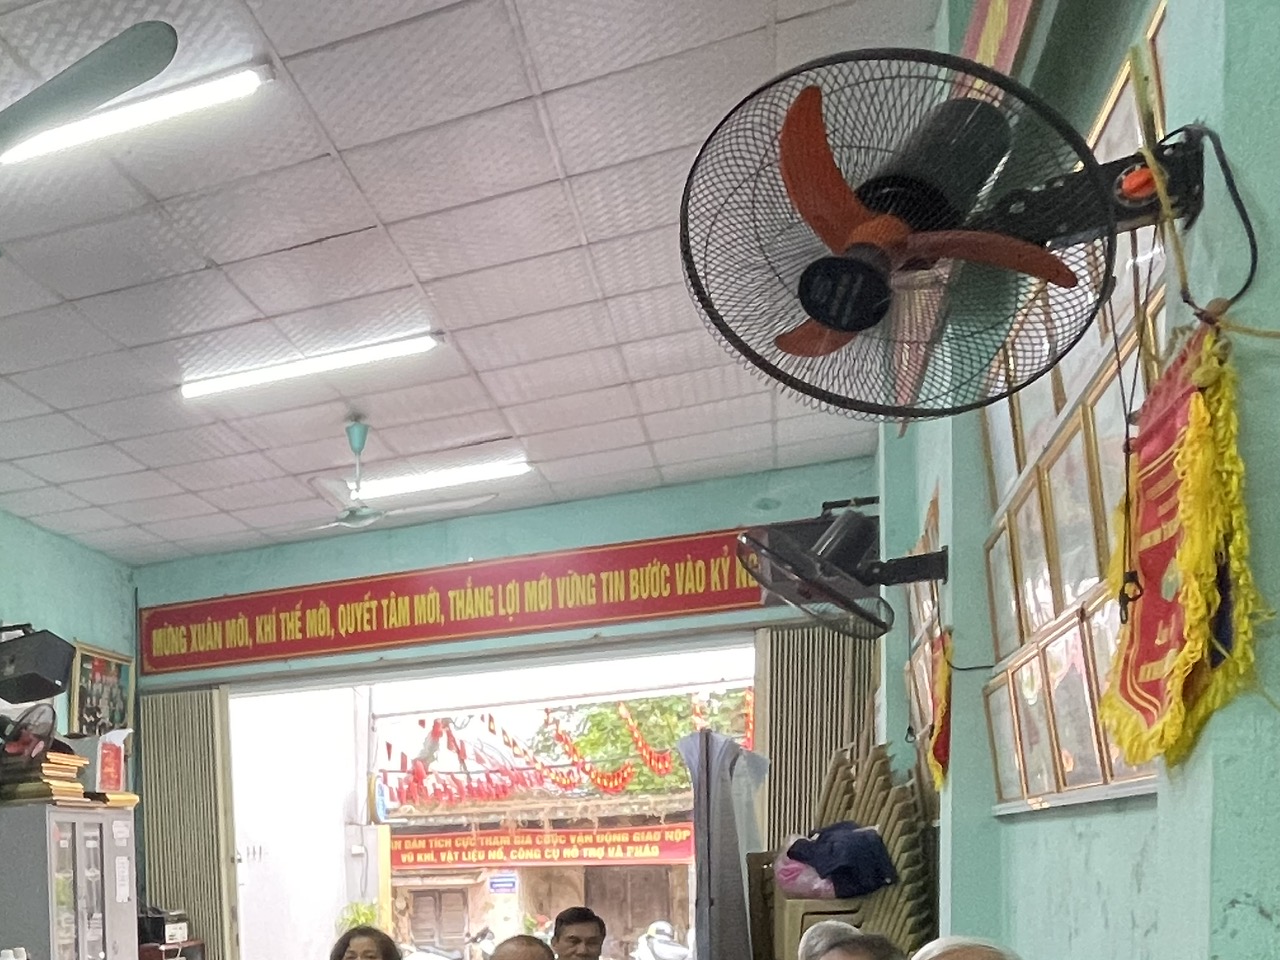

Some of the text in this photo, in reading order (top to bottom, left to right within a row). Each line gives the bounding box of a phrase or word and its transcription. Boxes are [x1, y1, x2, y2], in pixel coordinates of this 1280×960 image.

[152, 622, 187, 657] MỪNG
[189, 617, 222, 654] XUÂN
[225, 612, 252, 649] MỚI,
[256, 607, 277, 644] KHÍ
[279, 599, 303, 641] THẾ
[306, 600, 335, 640] MỚI,
[338, 591, 378, 637] QUYẾT
[381, 590, 410, 629] TÂM
[414, 586, 445, 627] MỚI,
[448, 576, 494, 621] THẮNG
[498, 578, 520, 622] LỢI
[524, 572, 553, 613] MỚI
[556, 568, 597, 608] VỮNG
[600, 570, 625, 603] TIN
[629, 558, 671, 600] BƯỚC
[675, 554, 705, 595] VÀO
[710, 545, 731, 592] KỶ
